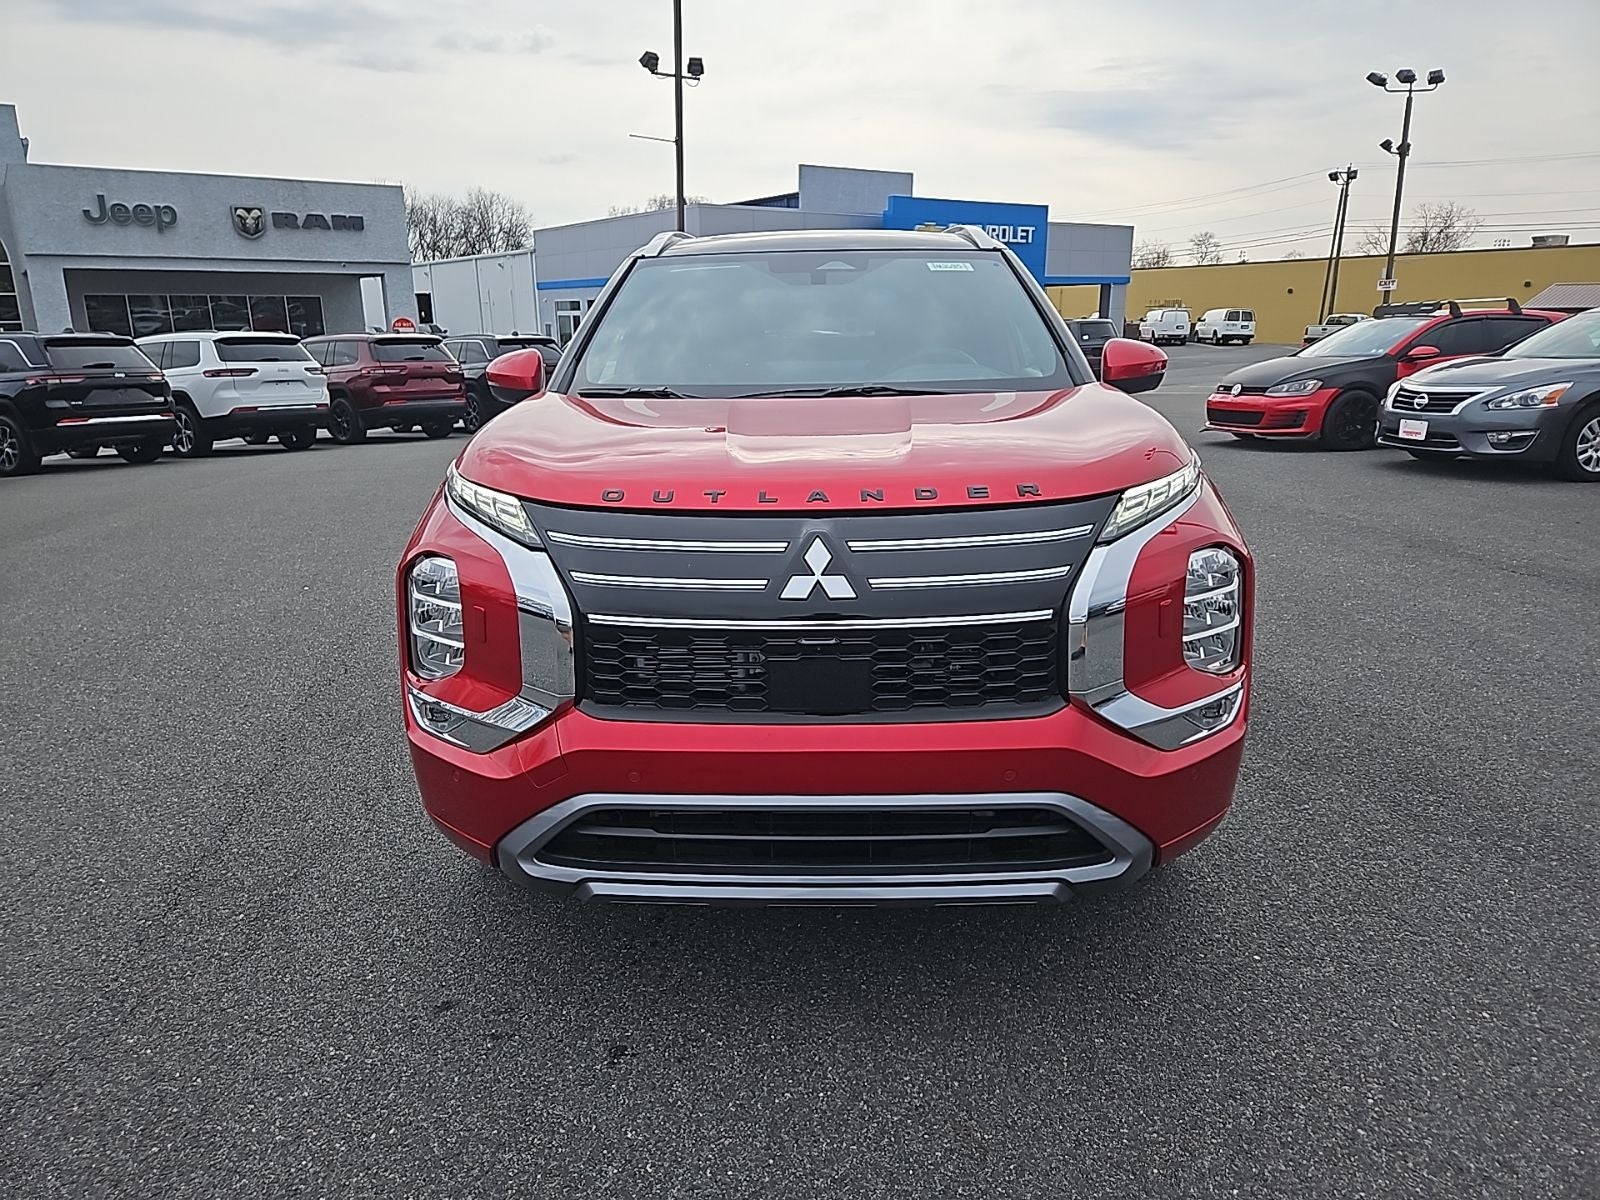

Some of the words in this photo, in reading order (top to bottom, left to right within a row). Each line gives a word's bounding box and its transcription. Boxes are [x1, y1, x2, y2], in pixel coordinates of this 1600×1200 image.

[82, 193, 178, 234] Jeep
[271, 211, 365, 231] RAM
[601, 483, 1043, 504] OUTLANDER
